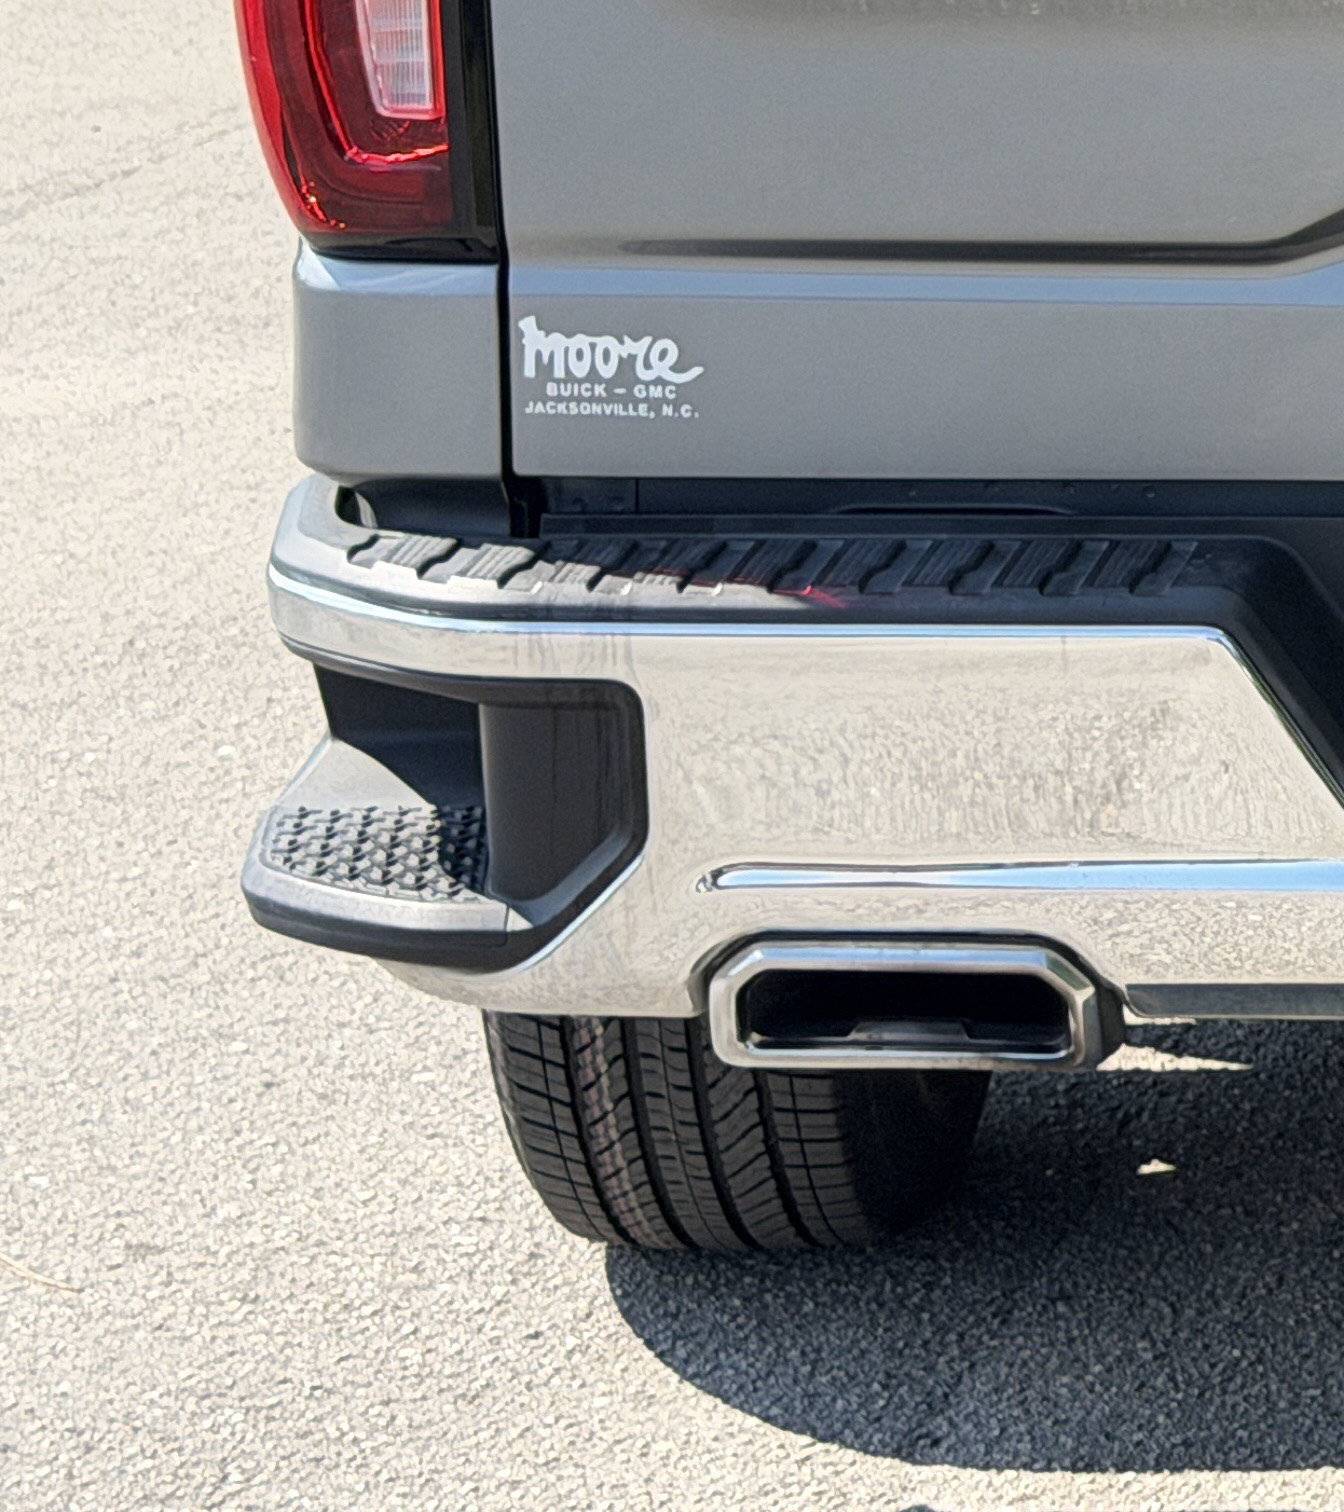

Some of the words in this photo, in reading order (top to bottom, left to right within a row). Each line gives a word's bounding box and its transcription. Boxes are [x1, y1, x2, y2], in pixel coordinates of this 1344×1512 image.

[546, 382, 607, 398] BUICK
[633, 385, 677, 399] GMC
[524, 400, 656, 419] JACKSONVILLE,
[662, 402, 700, 418] N.C.
